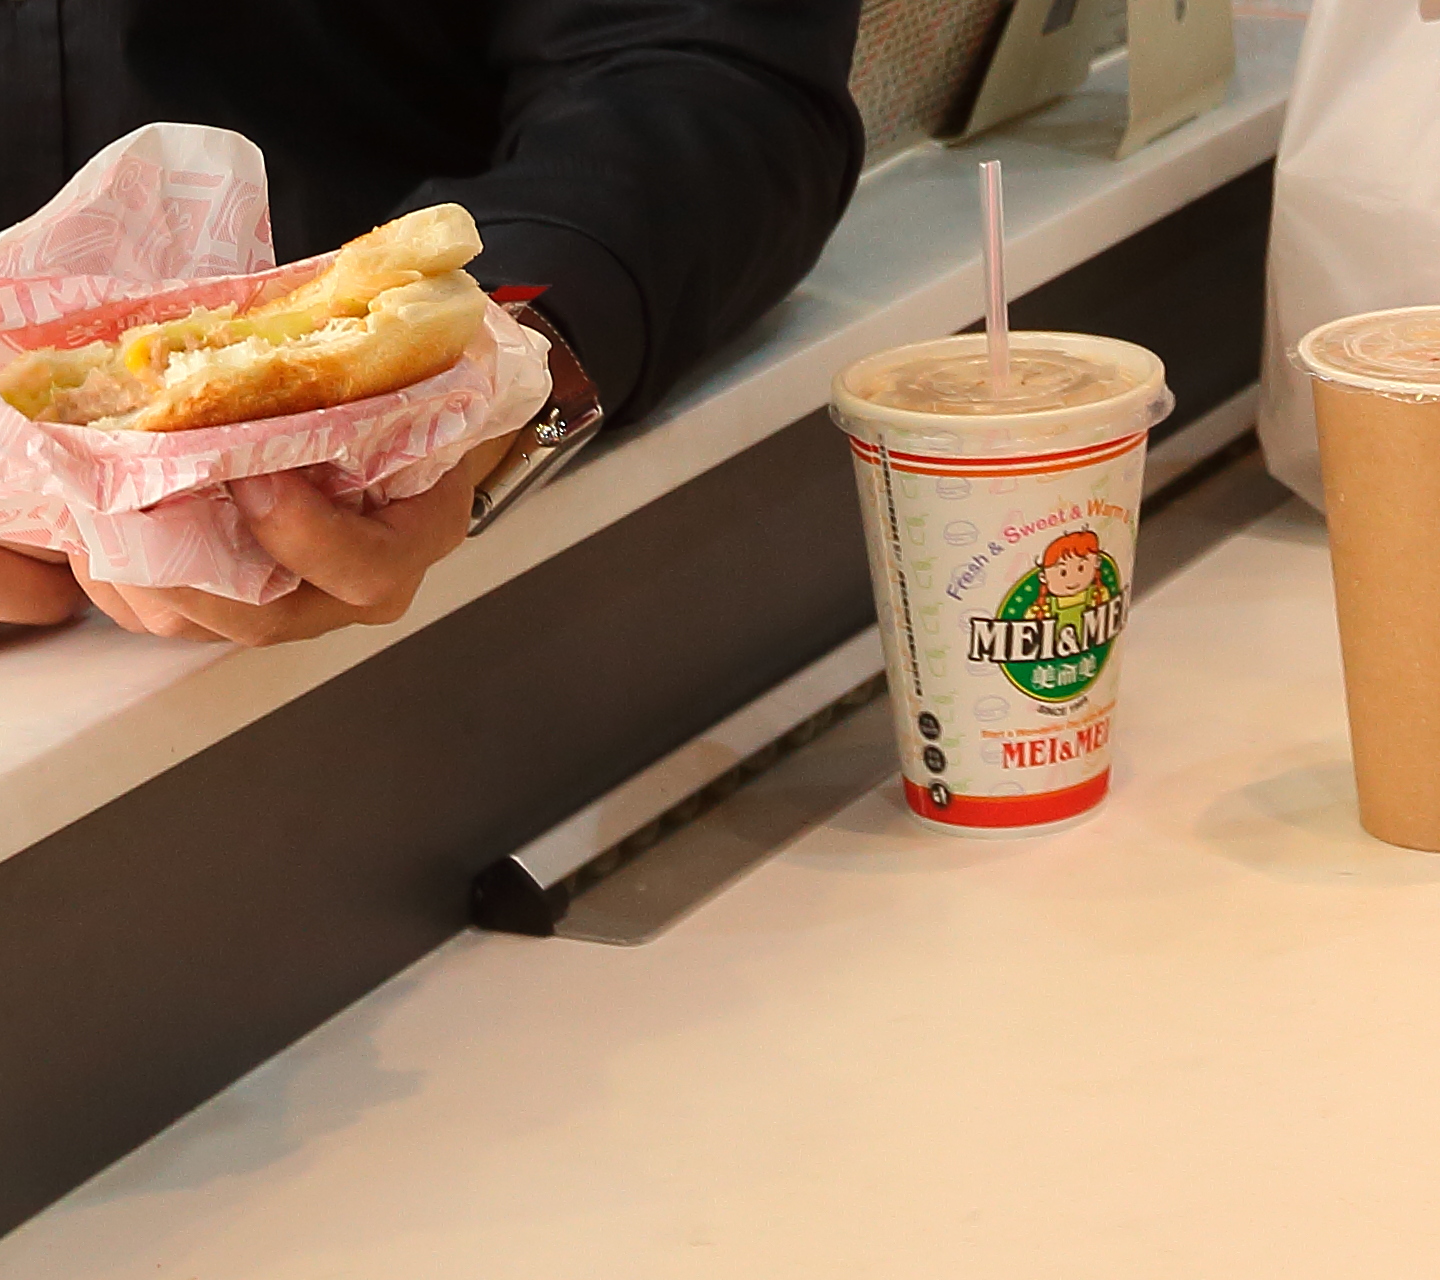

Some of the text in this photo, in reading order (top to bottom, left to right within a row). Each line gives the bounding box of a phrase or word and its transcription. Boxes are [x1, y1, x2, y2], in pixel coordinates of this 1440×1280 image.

[946, 552, 990, 601] Fresh
[987, 541, 1005, 557] &
[1003, 510, 1068, 544] Sweet
[1070, 504, 1083, 521] &
